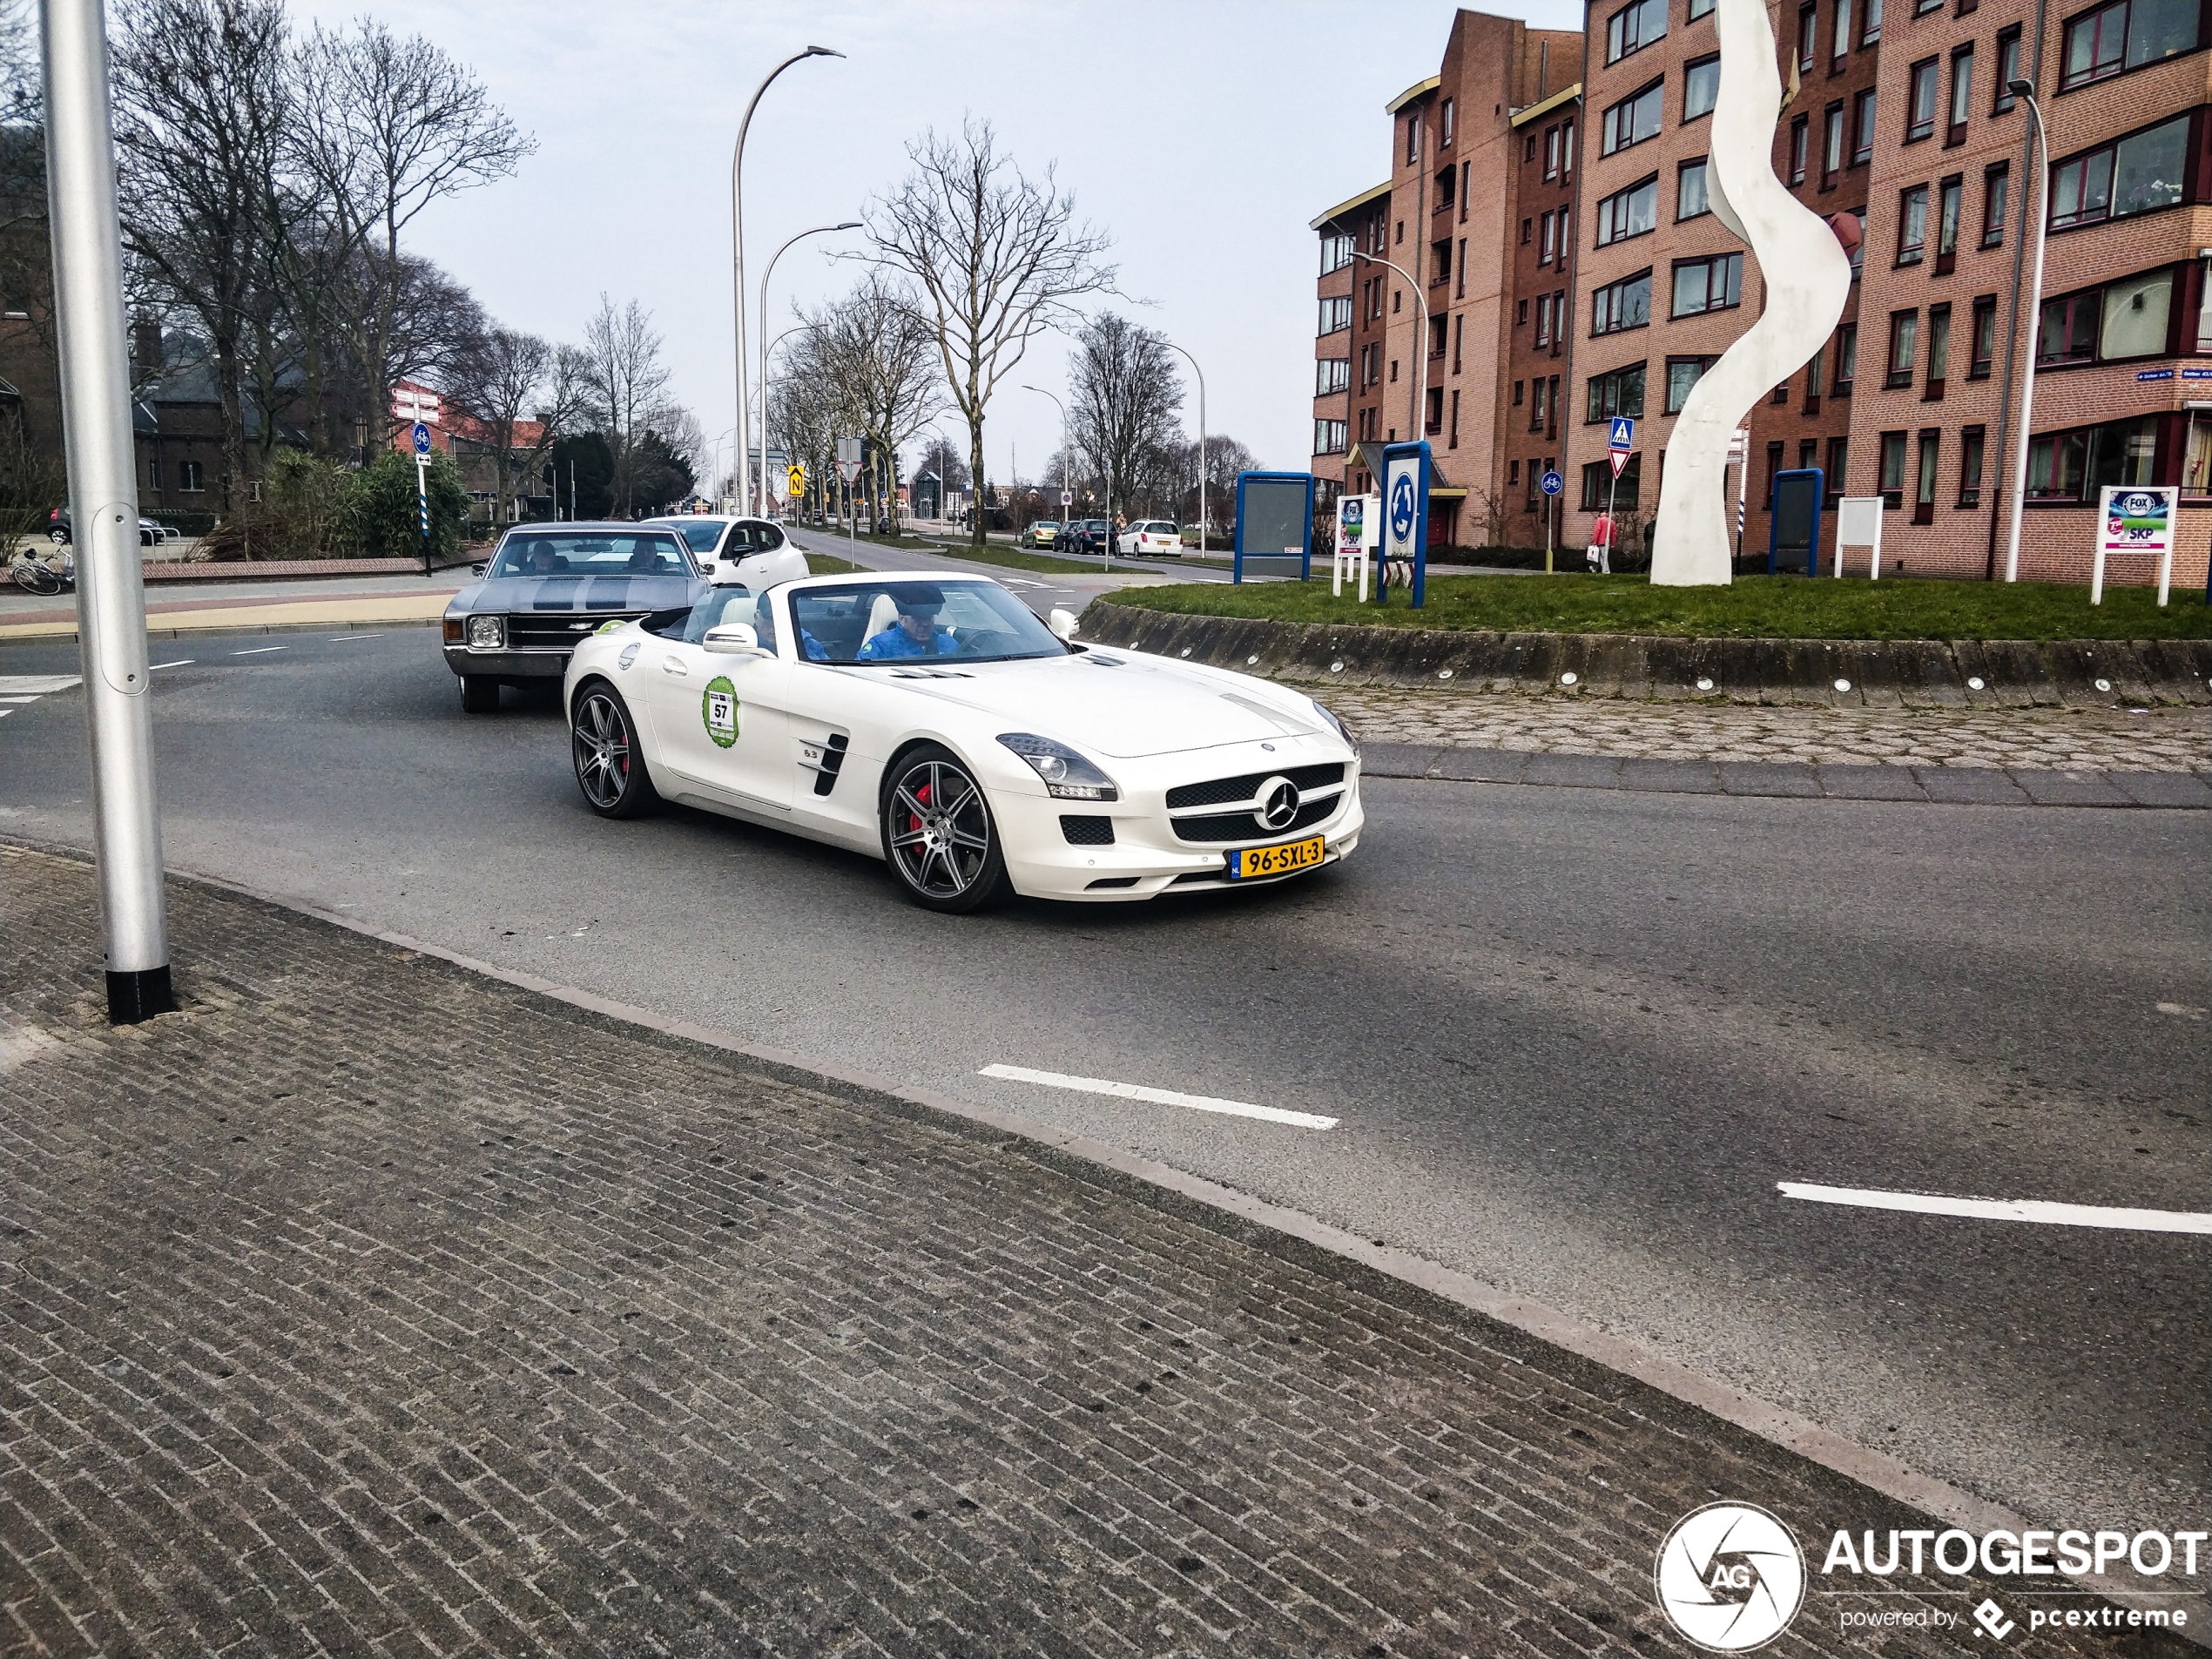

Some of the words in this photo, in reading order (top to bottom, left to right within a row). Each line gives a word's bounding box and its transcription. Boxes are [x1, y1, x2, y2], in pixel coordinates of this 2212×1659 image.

[792, 479, 799, 490] N
[2130, 498, 2148, 507] FOX
[2129, 527, 2154, 540] SKP
[714, 704, 727, 718] 57
[1249, 841, 1319, 873] 96-SXL-3
